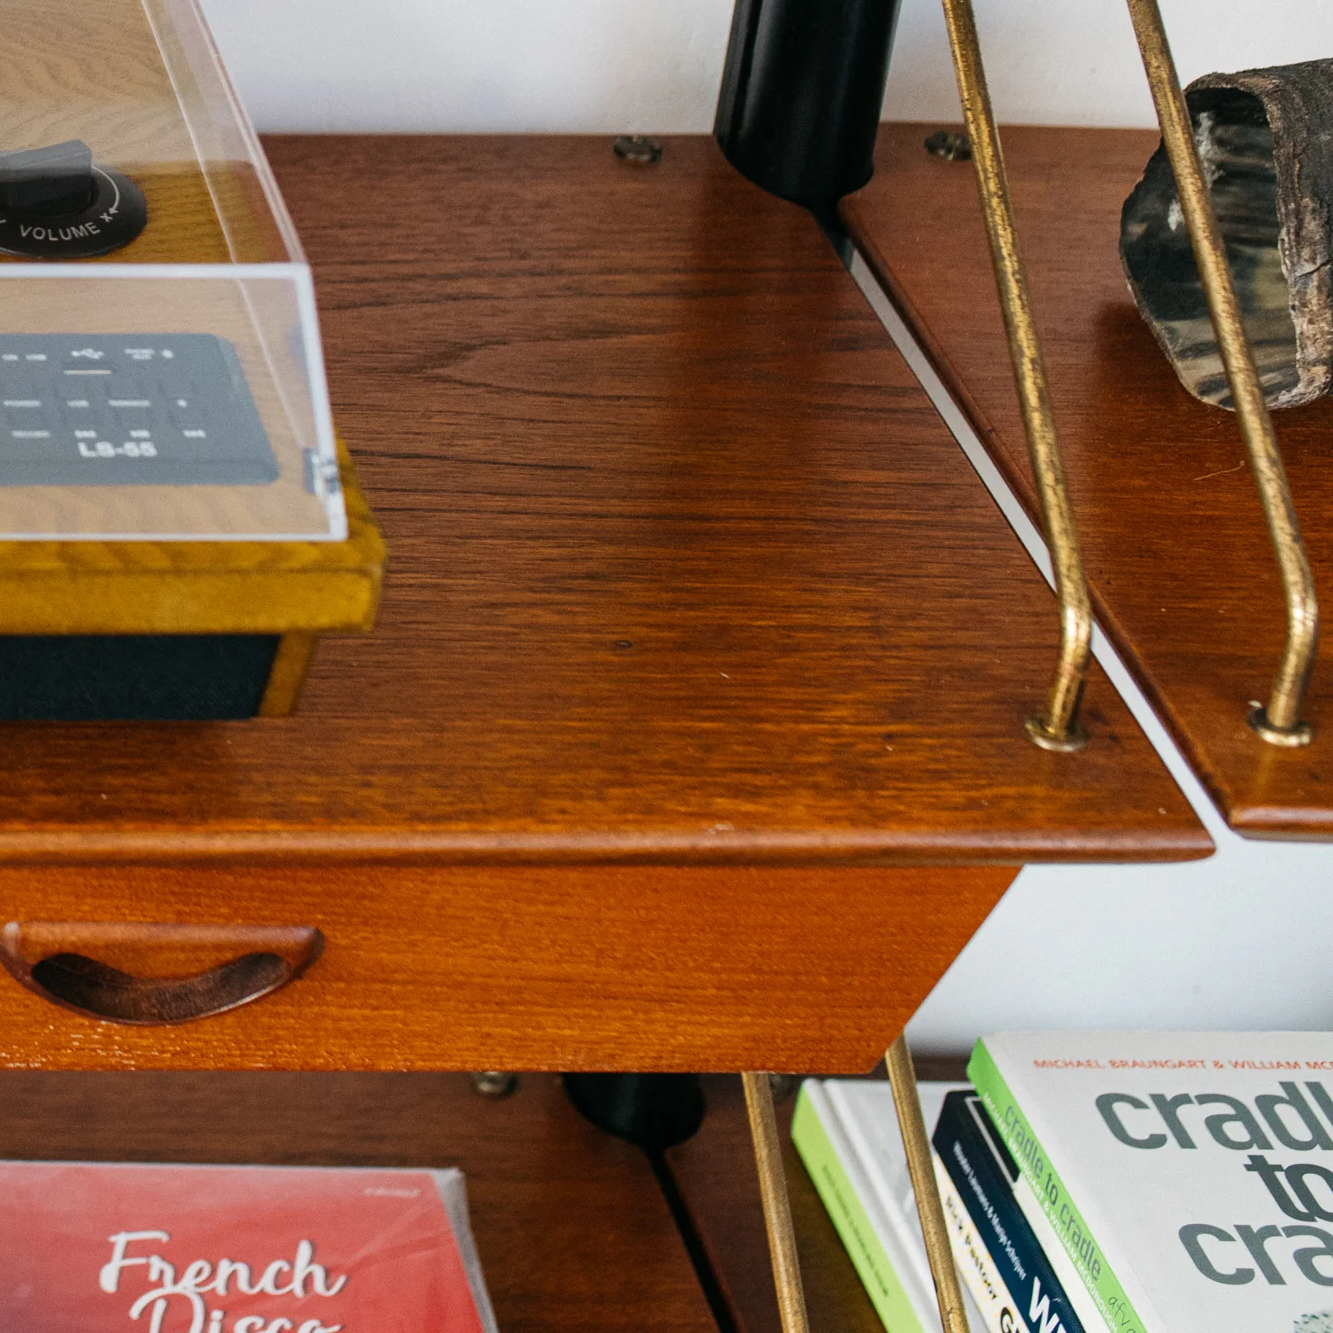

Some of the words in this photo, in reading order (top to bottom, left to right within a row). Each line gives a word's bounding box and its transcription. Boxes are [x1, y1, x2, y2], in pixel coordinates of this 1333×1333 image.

[19, 222, 101, 241] VOLUME
[1228, 1059, 1301, 1070] WILLIAM
[1004, 1105, 1045, 1179] cradle
[1045, 1172, 1059, 1206] to
[1059, 1203, 1102, 1282] cradle
[1242, 1154, 1333, 1223] to
[99, 1229, 348, 1298] French
